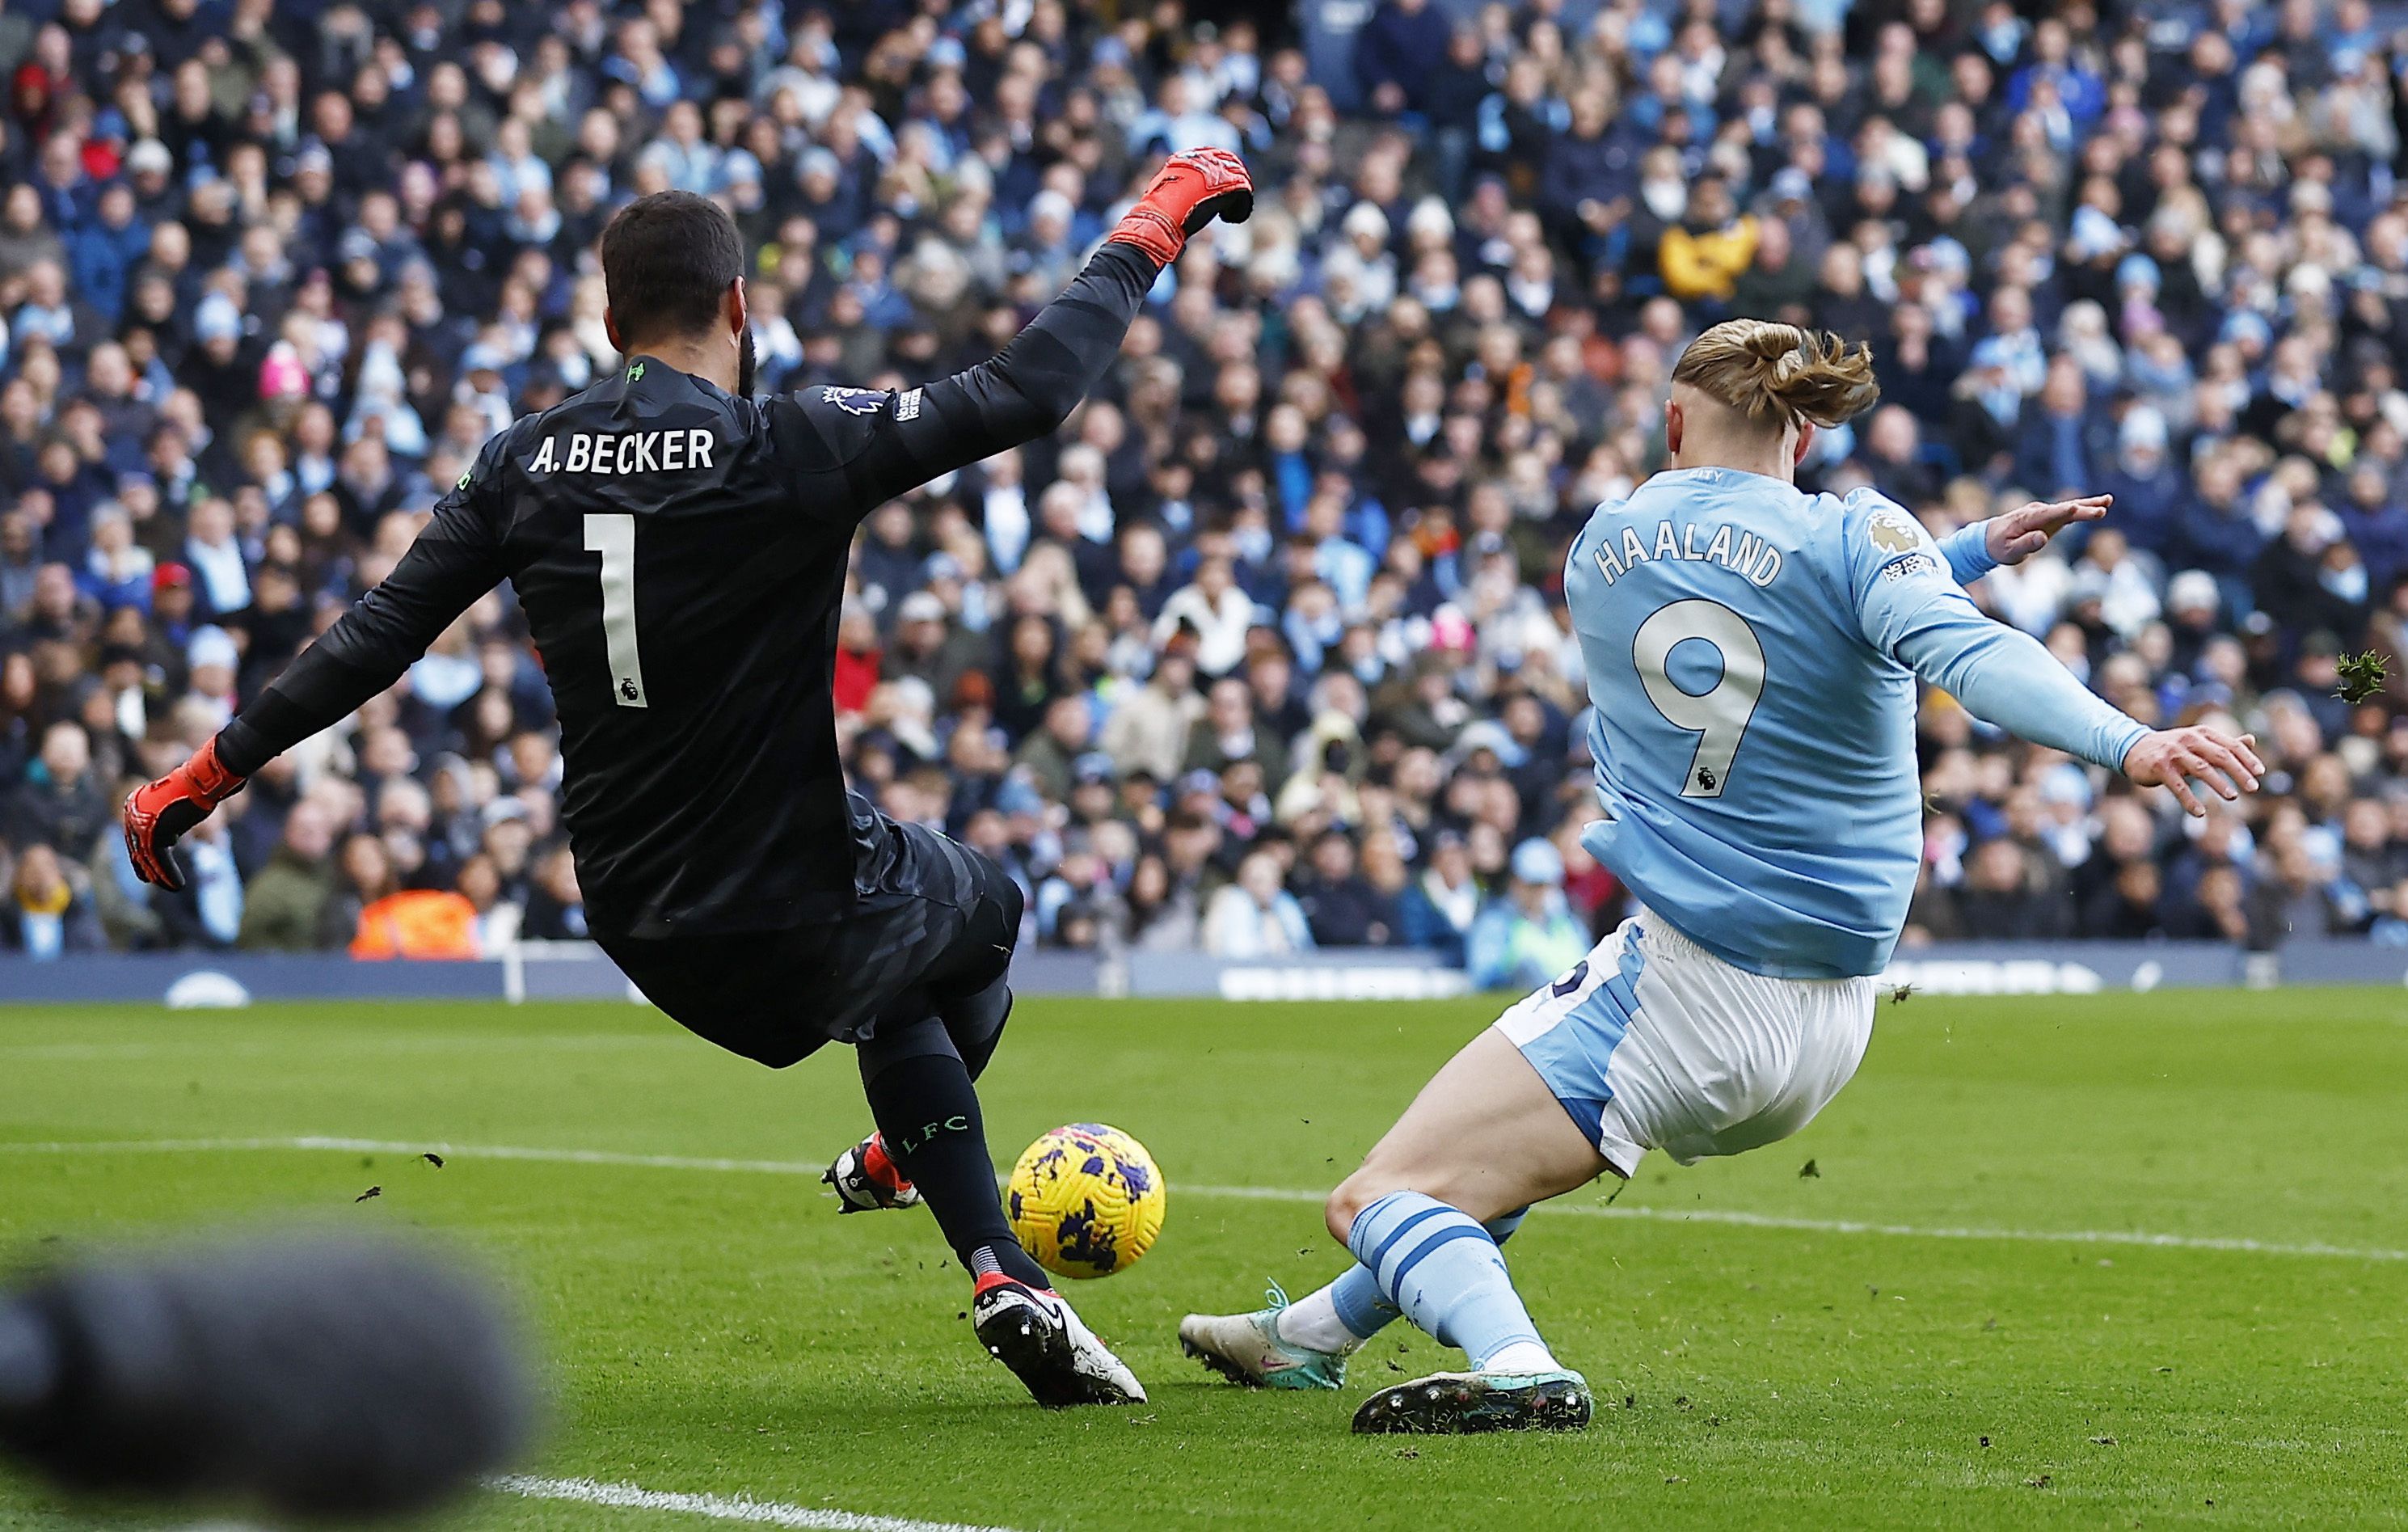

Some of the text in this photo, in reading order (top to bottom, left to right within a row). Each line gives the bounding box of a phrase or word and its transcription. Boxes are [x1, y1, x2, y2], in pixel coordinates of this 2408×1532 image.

[528, 428, 714, 475] A.BECKER
[1594, 520, 1782, 587] HAALAND
[1882, 563, 1902, 576] No
[584, 513, 647, 707] 1
[1632, 597, 1766, 797] 9
[902, 1116, 968, 1154] LFC
